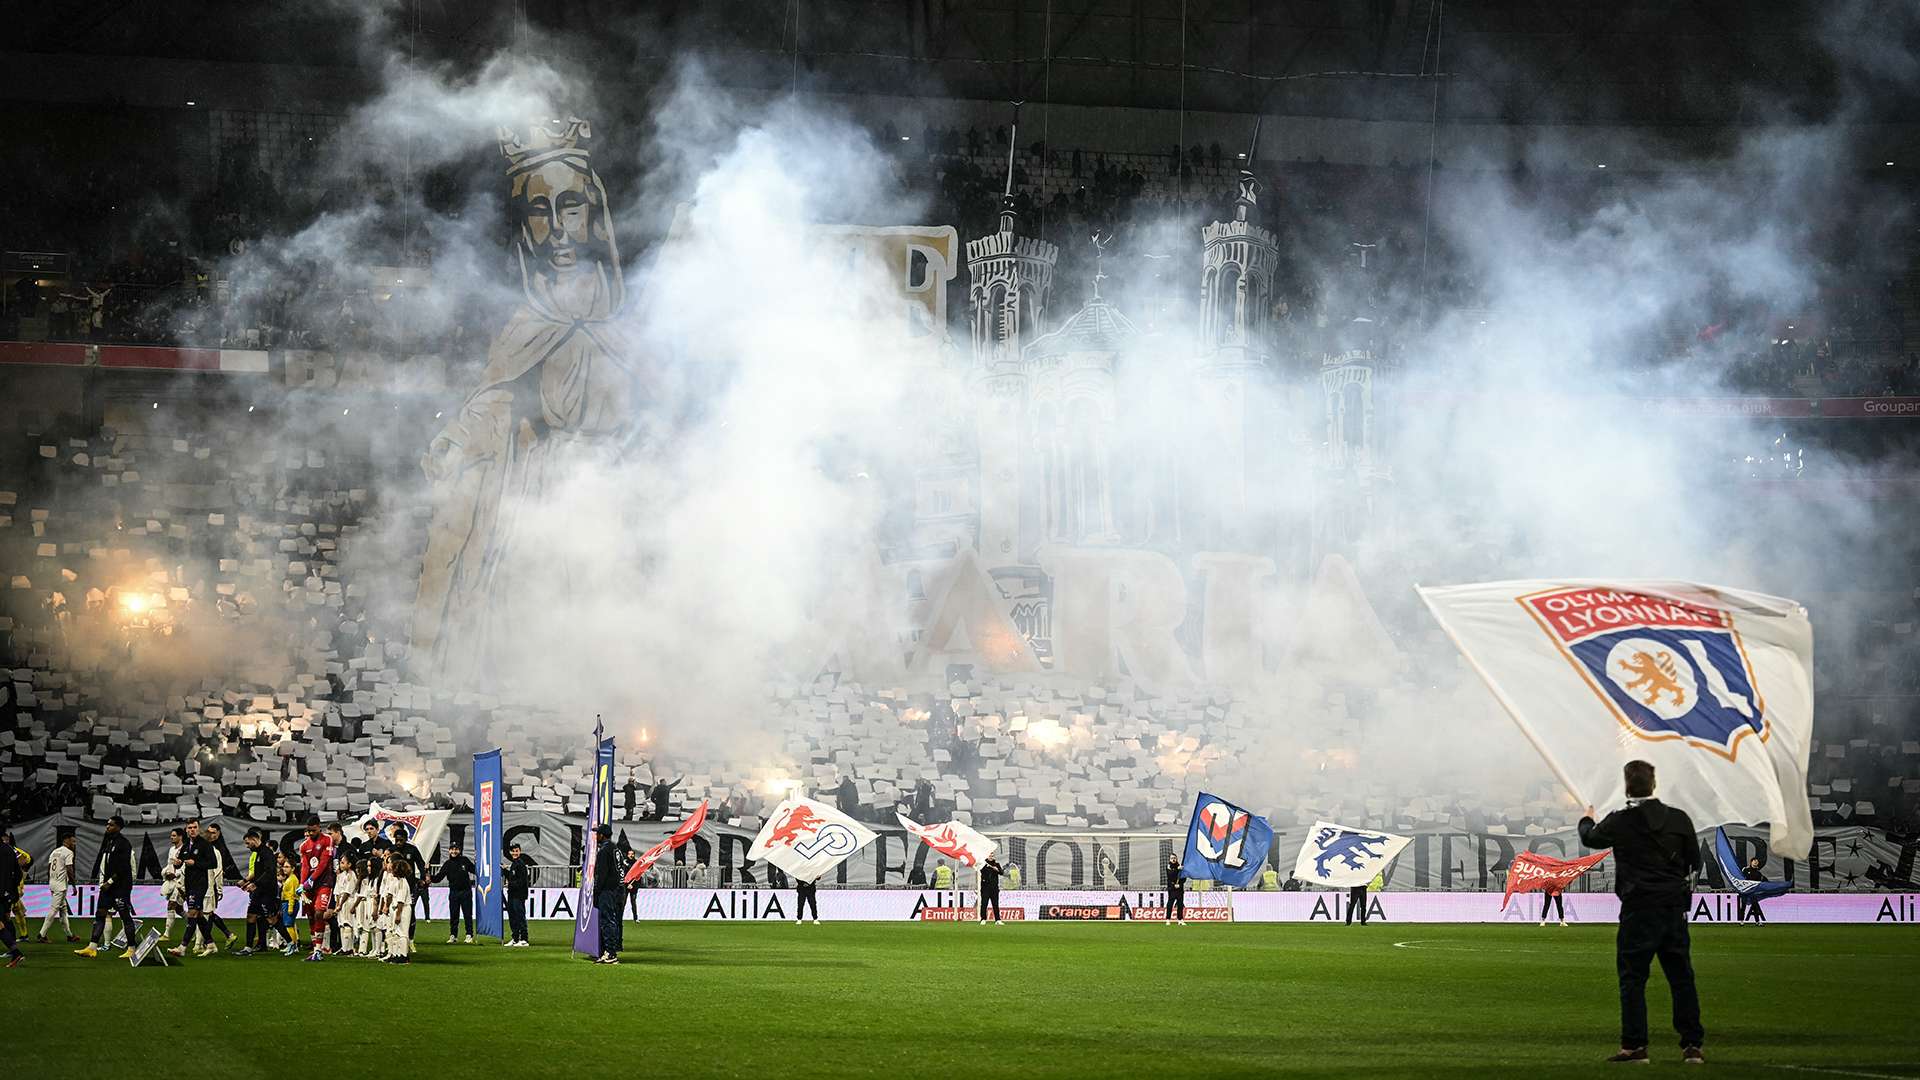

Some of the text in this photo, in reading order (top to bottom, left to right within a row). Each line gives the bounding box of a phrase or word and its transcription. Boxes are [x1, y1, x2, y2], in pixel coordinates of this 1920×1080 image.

[1545, 591, 1685, 612] OLYMP
[800, 543, 1406, 682] ARIA
[51, 859, 57, 871] 8
[1694, 836, 1837, 888] ARIE
[502, 890, 574, 917] ilA
[703, 891, 785, 918] AlilA
[910, 892, 965, 919] Alil
[1118, 893, 1164, 919] Alil
[1049, 906, 1099, 918] Orange
[998, 909, 1021, 919] ETTER
[1135, 907, 1228, 919] Betclc Betclic
